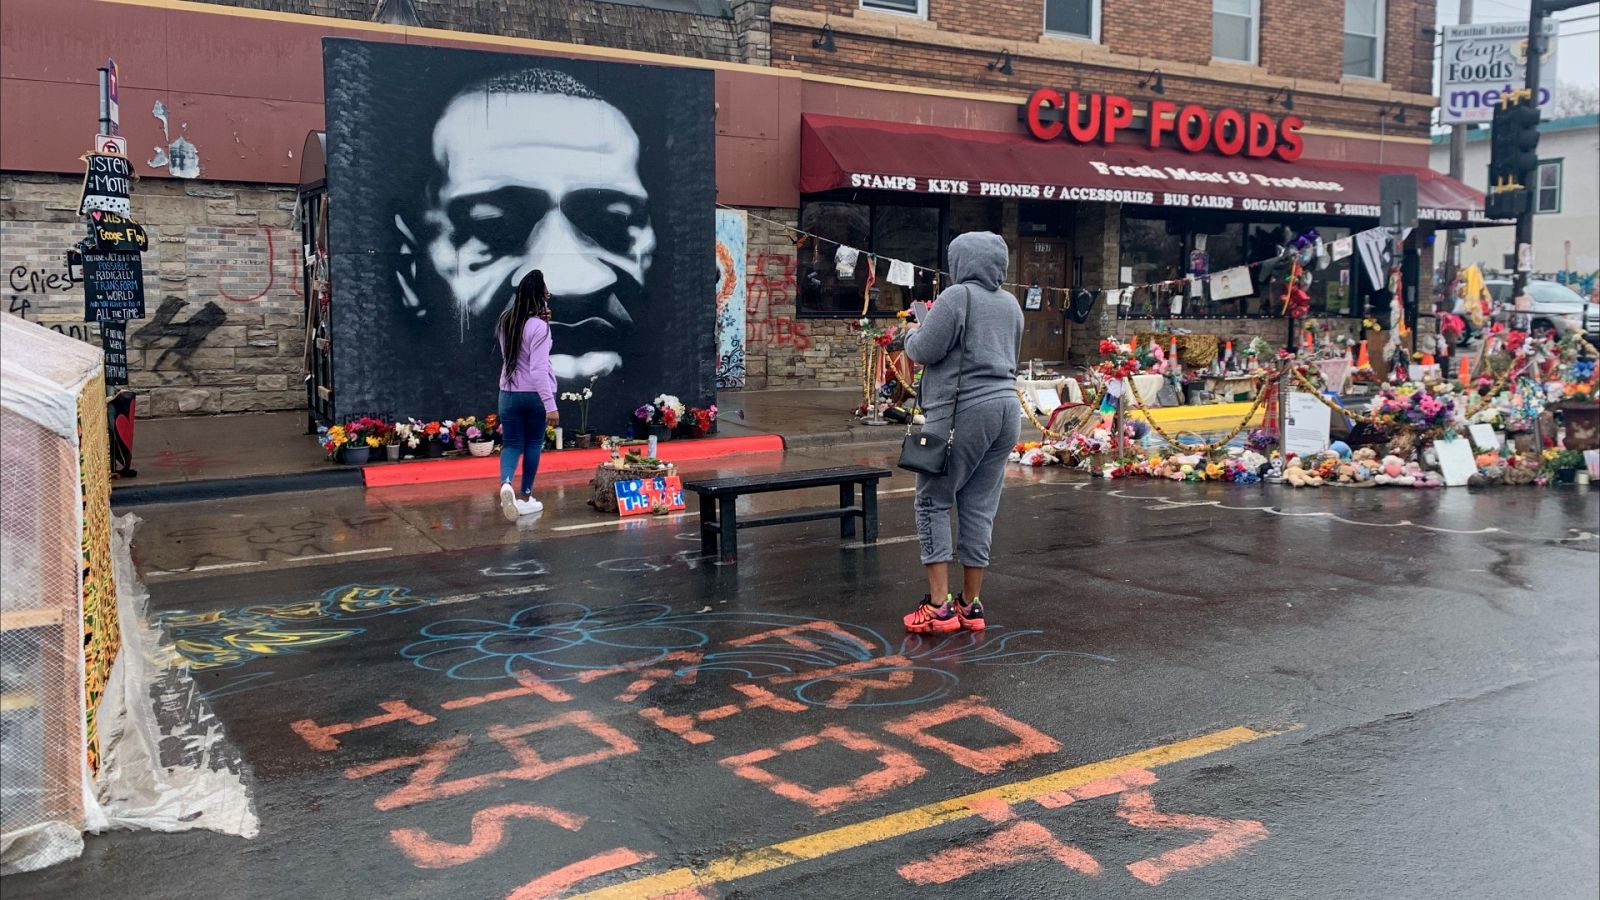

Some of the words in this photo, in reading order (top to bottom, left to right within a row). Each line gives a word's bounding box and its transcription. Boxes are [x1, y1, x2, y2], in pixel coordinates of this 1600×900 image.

[1456, 40, 1511, 65] Cup
[1449, 60, 1513, 81] Foods
[1026, 87, 1133, 143] CUP
[1149, 100, 1305, 161] FOODS
[1089, 161, 1168, 179] Fresh
[1164, 167, 1229, 184] Meat
[1227, 171, 1250, 185] &
[1250, 173, 1344, 191] Produce
[851, 173, 916, 190] STAMPS
[928, 179, 969, 194] KEYS
[980, 182, 1040, 198] PHONES
[1043, 185, 1055, 198] &
[1059, 187, 1154, 204] ACCESSORIES
[1163, 193, 1189, 206] BUS
[1191, 195, 1234, 209] CARDS
[1242, 198, 1296, 212] ORGANIC
[1298, 201, 1327, 213] MILK
[1334, 203, 1381, 216] T-SHIRTS
[1435, 209, 1462, 221] FOOD
[98, 262, 130, 271] POSSIBLE
[10, 265, 74, 294] Cries
[105, 290, 134, 300] WORLD
[96, 308, 111, 320] ALL
[620, 495, 649, 511] THE
